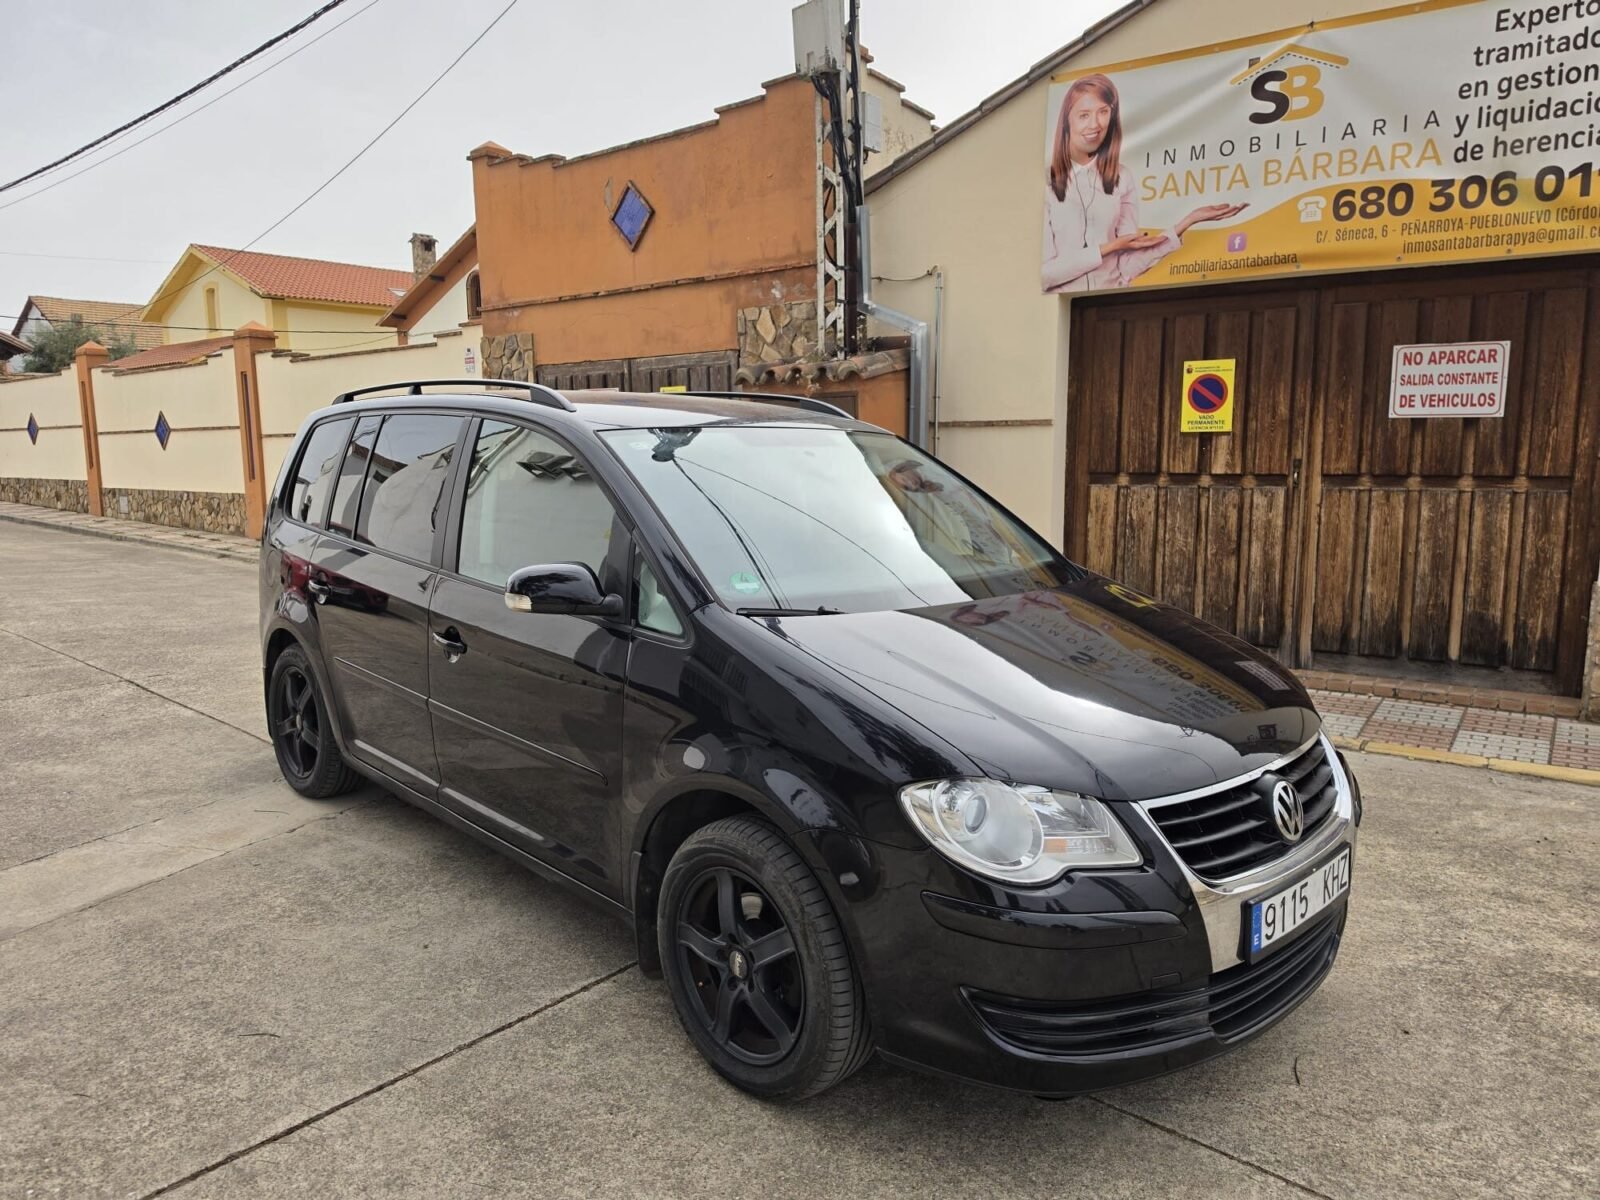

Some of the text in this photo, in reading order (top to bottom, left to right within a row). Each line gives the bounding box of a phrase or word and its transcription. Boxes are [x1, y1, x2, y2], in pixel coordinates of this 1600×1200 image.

[1495, 0, 1600, 33] Experto
[1249, 64, 1325, 124] SB
[1458, 62, 1599, 100] en gestion
[1146, 110, 1440, 168] INMOBILIARIA
[1453, 114, 1469, 138] y
[1453, 123, 1600, 163] de herenci
[1141, 137, 1442, 201] SANTA BÁRBARA
[1332, 162, 1600, 222] 680 306 01
[1335, 227, 1377, 242] Séneca,
[1381, 224, 1388, 238] 6
[1401, 208, 1551, 236] PEÑARROYA-PUEBLONUEVO
[1556, 204, 1600, 224] (Córdo
[1403, 225, 1600, 255] inmosantabarbarapya@gmail.c
[1169, 252, 1298, 276] inmobiliariasantabarbara
[1403, 348, 1498, 366] NO APARCAR
[1400, 371, 1499, 386] SALIDA CONSTANTE
[1399, 392, 1496, 408] DE VEHICULOS
[1265, 853, 1348, 940] 9115 KHZ
